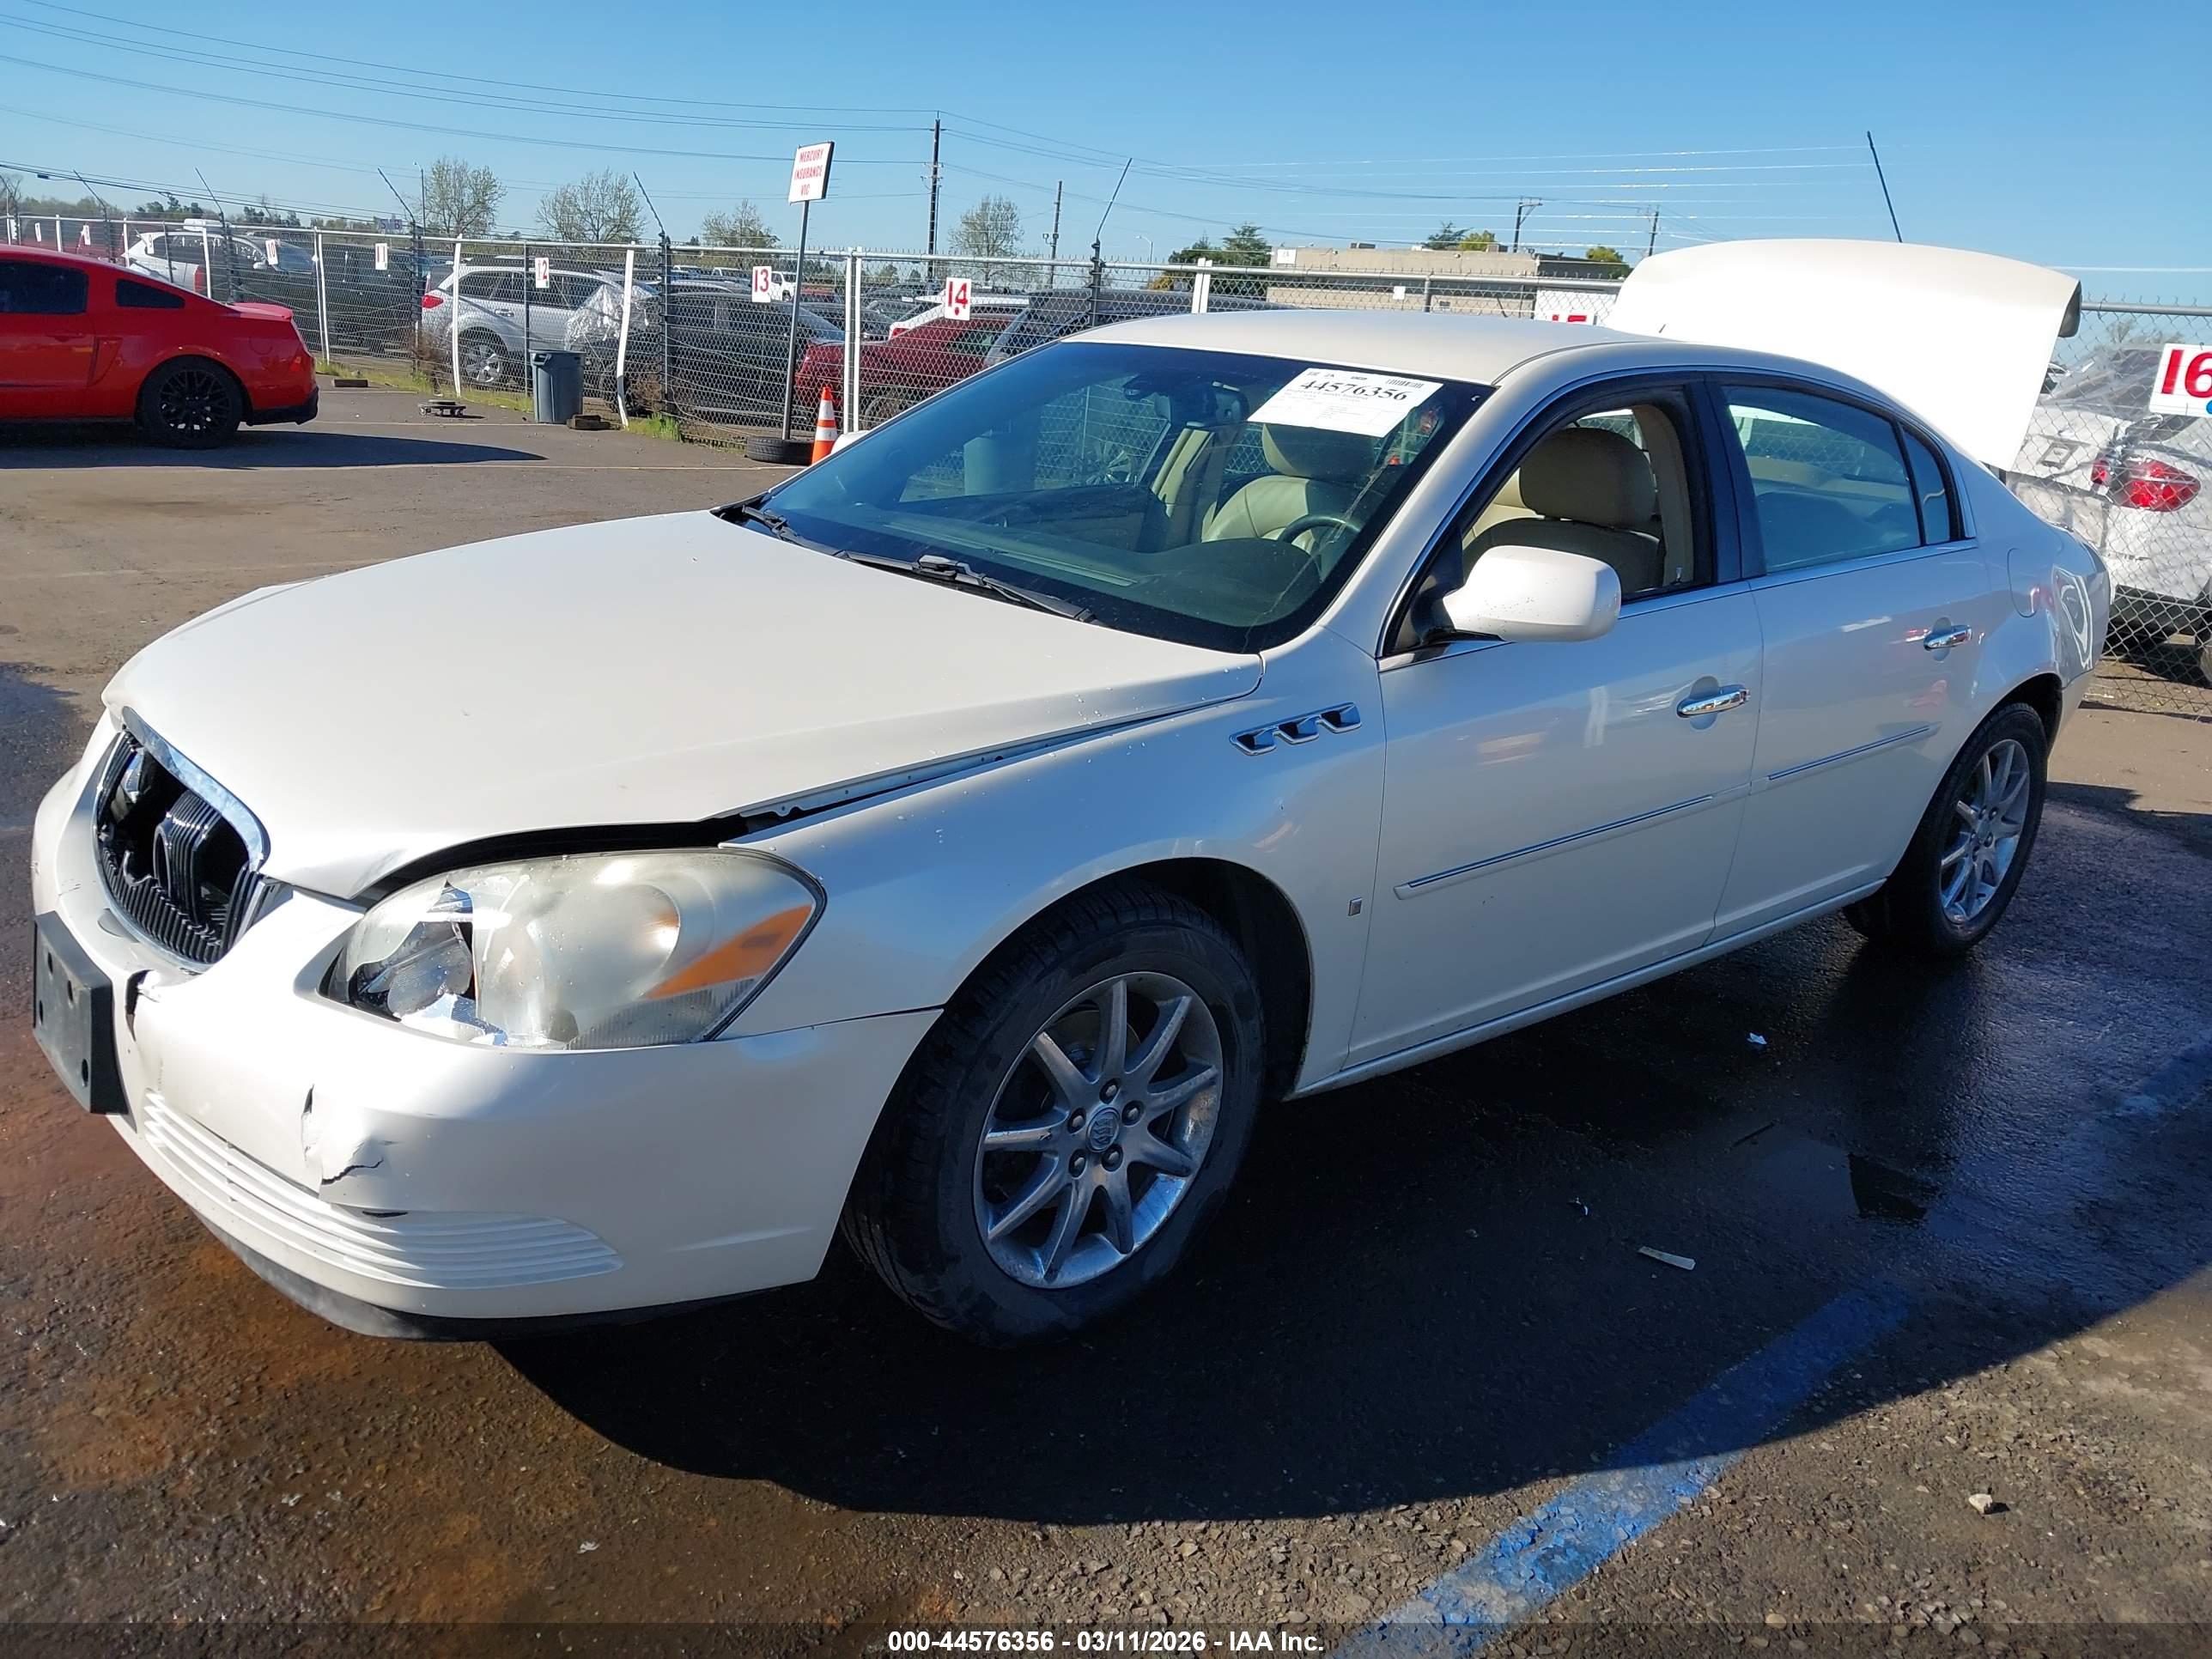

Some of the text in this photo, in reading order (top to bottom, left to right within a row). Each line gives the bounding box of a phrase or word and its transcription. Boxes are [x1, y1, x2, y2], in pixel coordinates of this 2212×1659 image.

[799, 148, 824, 163] MERCURY
[794, 165, 823, 180] INSURANCE
[268, 240, 276, 258] 10
[377, 246, 386, 264] 11
[538, 259, 548, 280] 12
[754, 268, 769, 293] 13
[947, 281, 969, 310] 14
[2160, 349, 2212, 398] 16
[1301, 380, 1413, 401] 44576356
